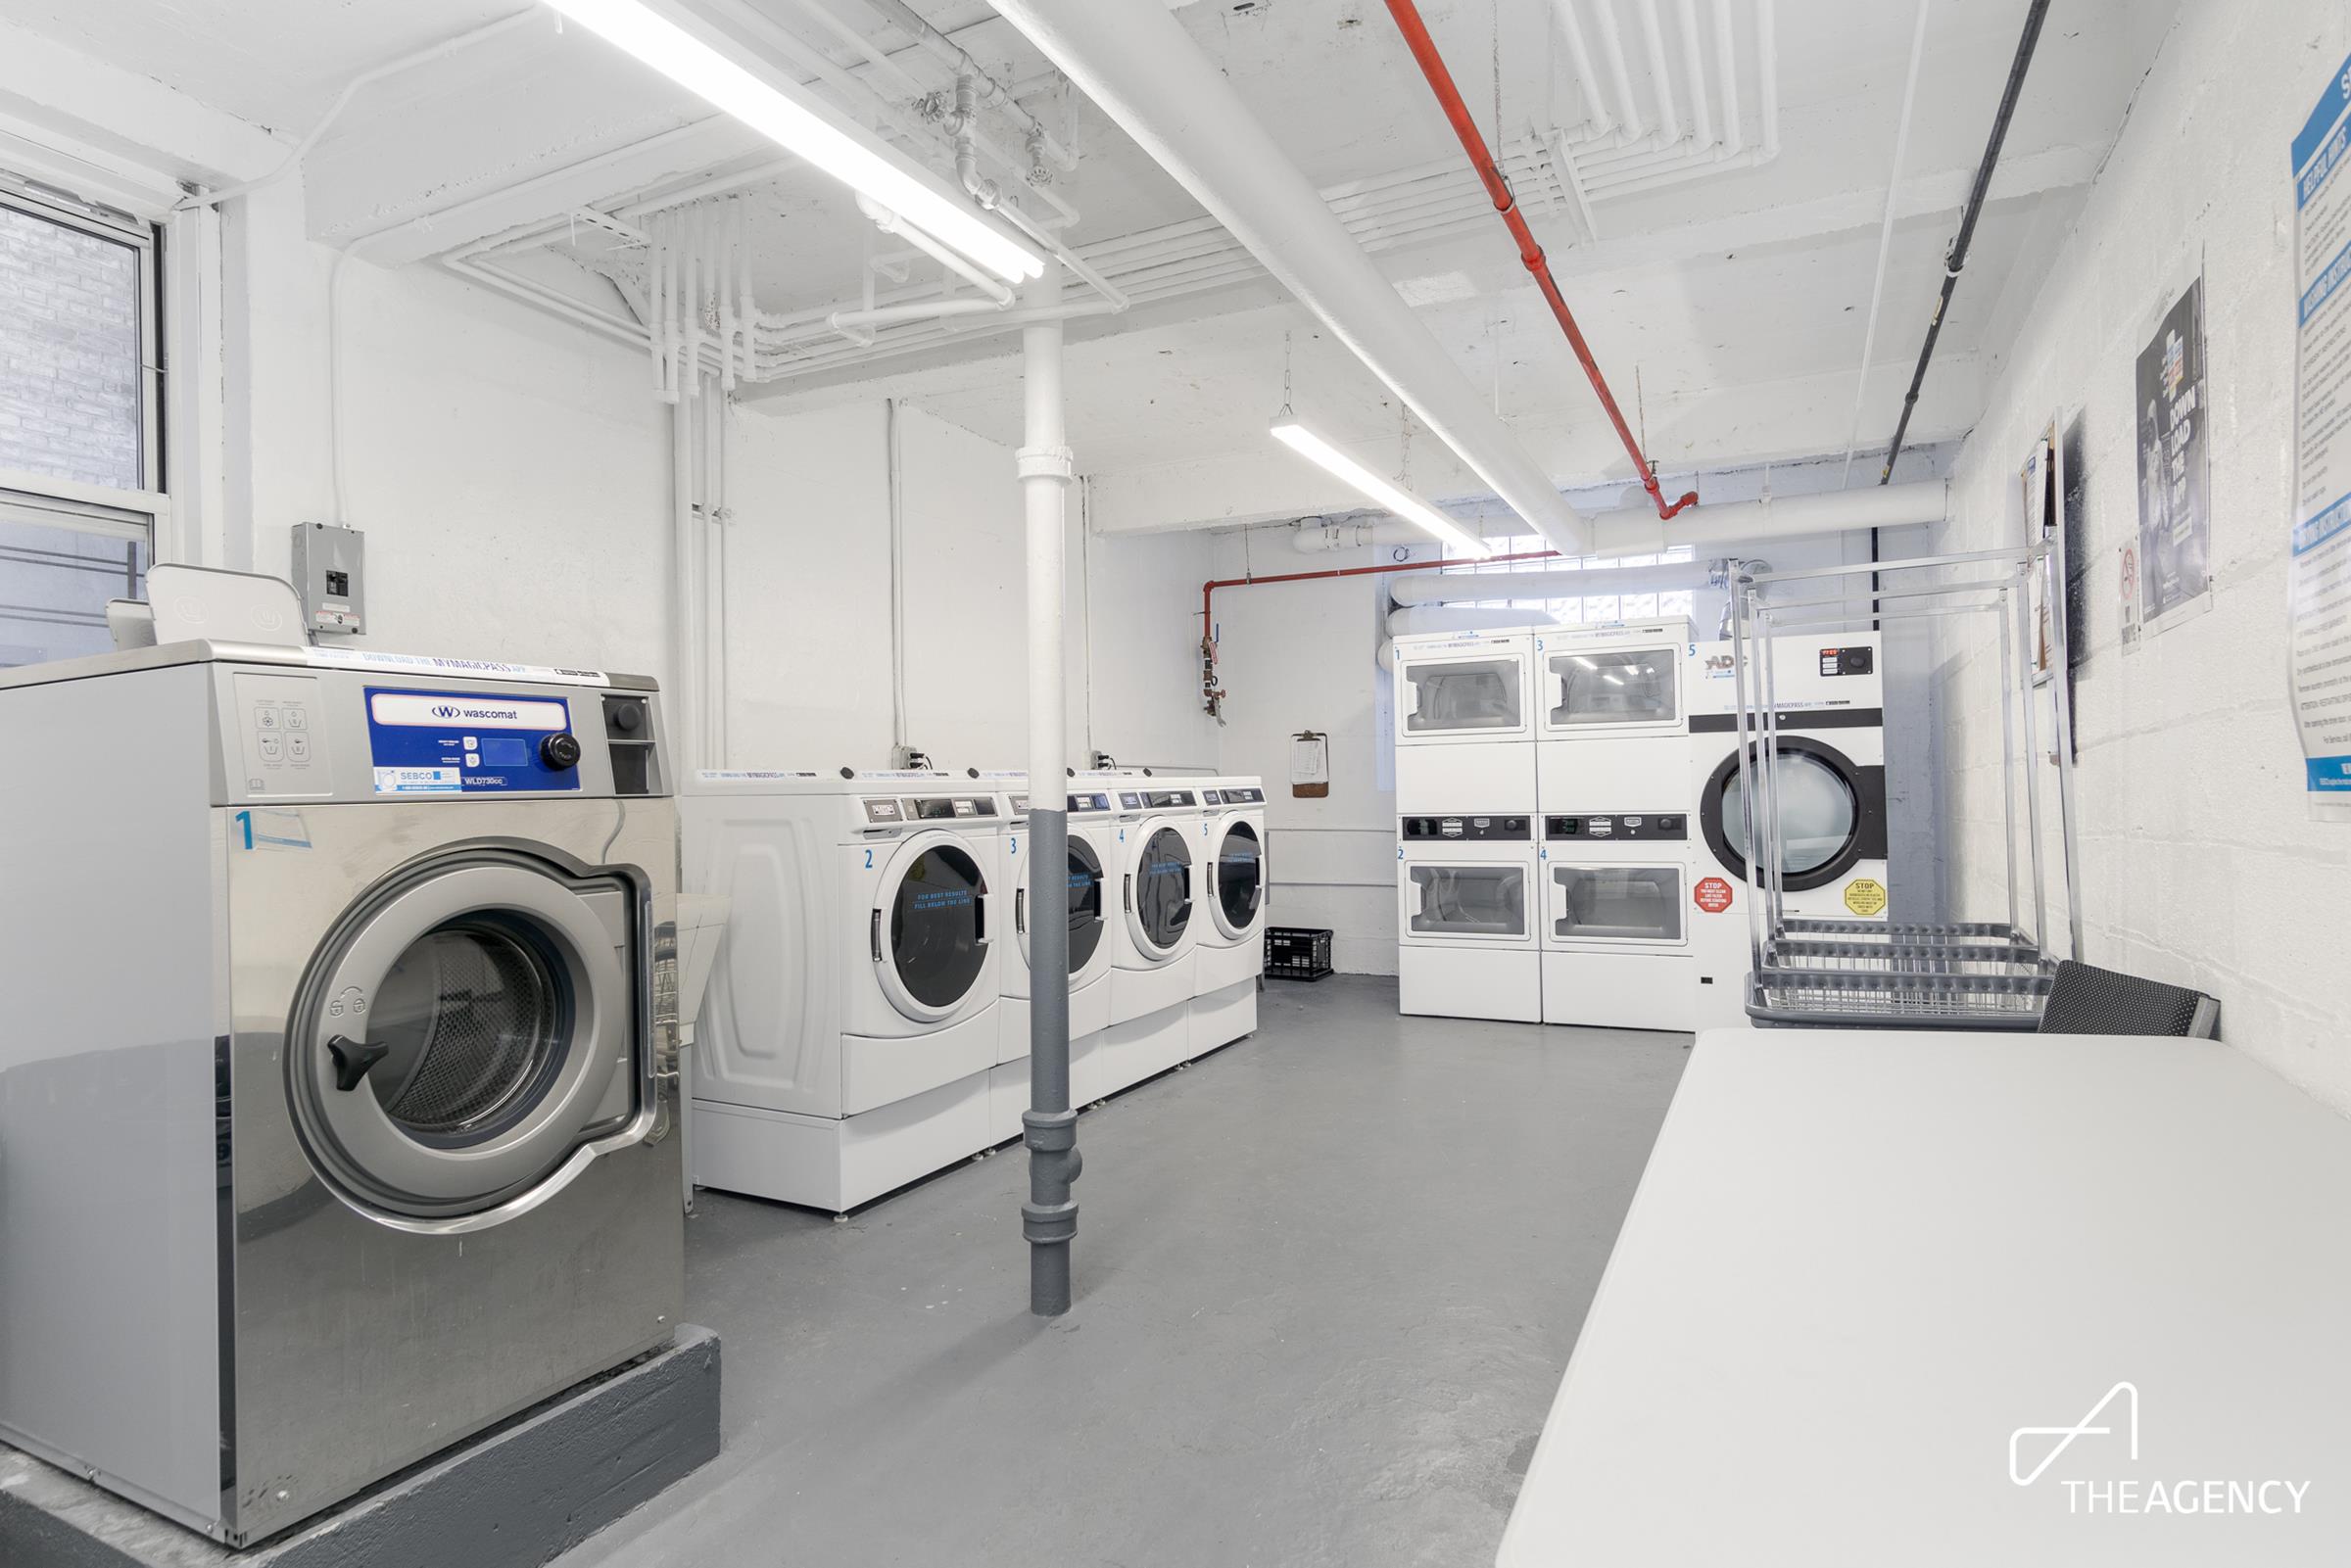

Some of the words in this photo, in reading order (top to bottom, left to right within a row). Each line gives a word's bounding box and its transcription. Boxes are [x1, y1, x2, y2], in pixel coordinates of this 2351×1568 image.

[2170, 385, 2196, 432] DOWN
[2171, 417, 2191, 458] LOAD
[1537, 640, 1543, 651] 3
[1688, 643, 1696, 657] 5
[1396, 649, 1400, 660] 1
[463, 708, 517, 720] wascomat
[401, 772, 433, 781] SEBCO
[235, 810, 254, 850] 1
[1119, 829, 1124, 842] 4
[1204, 824, 1208, 835] 5
[1011, 837, 1017, 854] 3
[865, 849, 873, 869] 2
[1397, 849, 1404, 860] 2
[1540, 849, 1547, 860] 4
